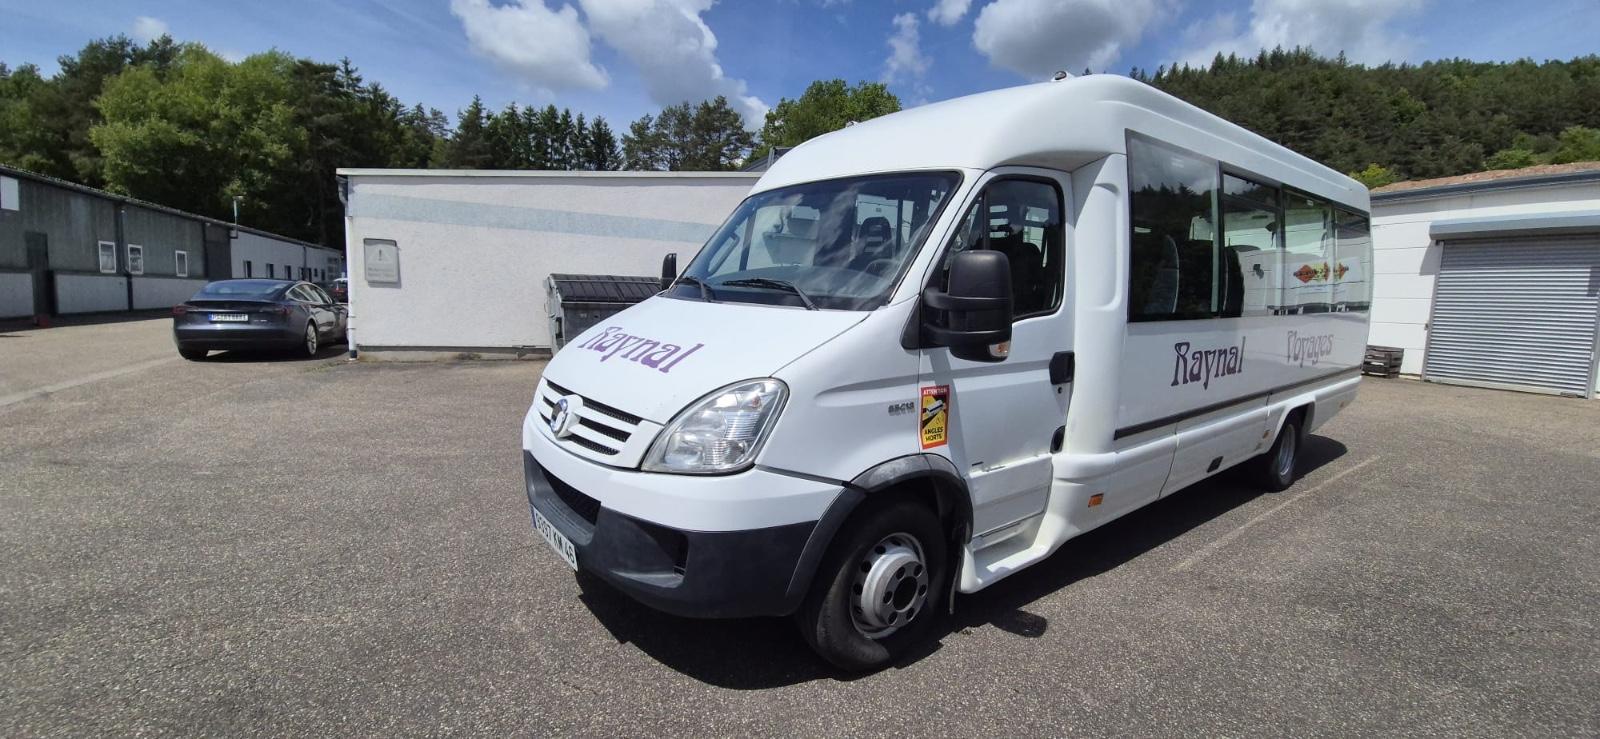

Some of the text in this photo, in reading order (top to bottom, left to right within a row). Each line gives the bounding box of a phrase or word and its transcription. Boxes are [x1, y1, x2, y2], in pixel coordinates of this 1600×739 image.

[577, 326, 704, 373] Raynal
[1171, 330, 1334, 391] Raynal Voyages
[924, 426, 944, 435] ANGLES
[925, 433, 942, 442] MORTS
